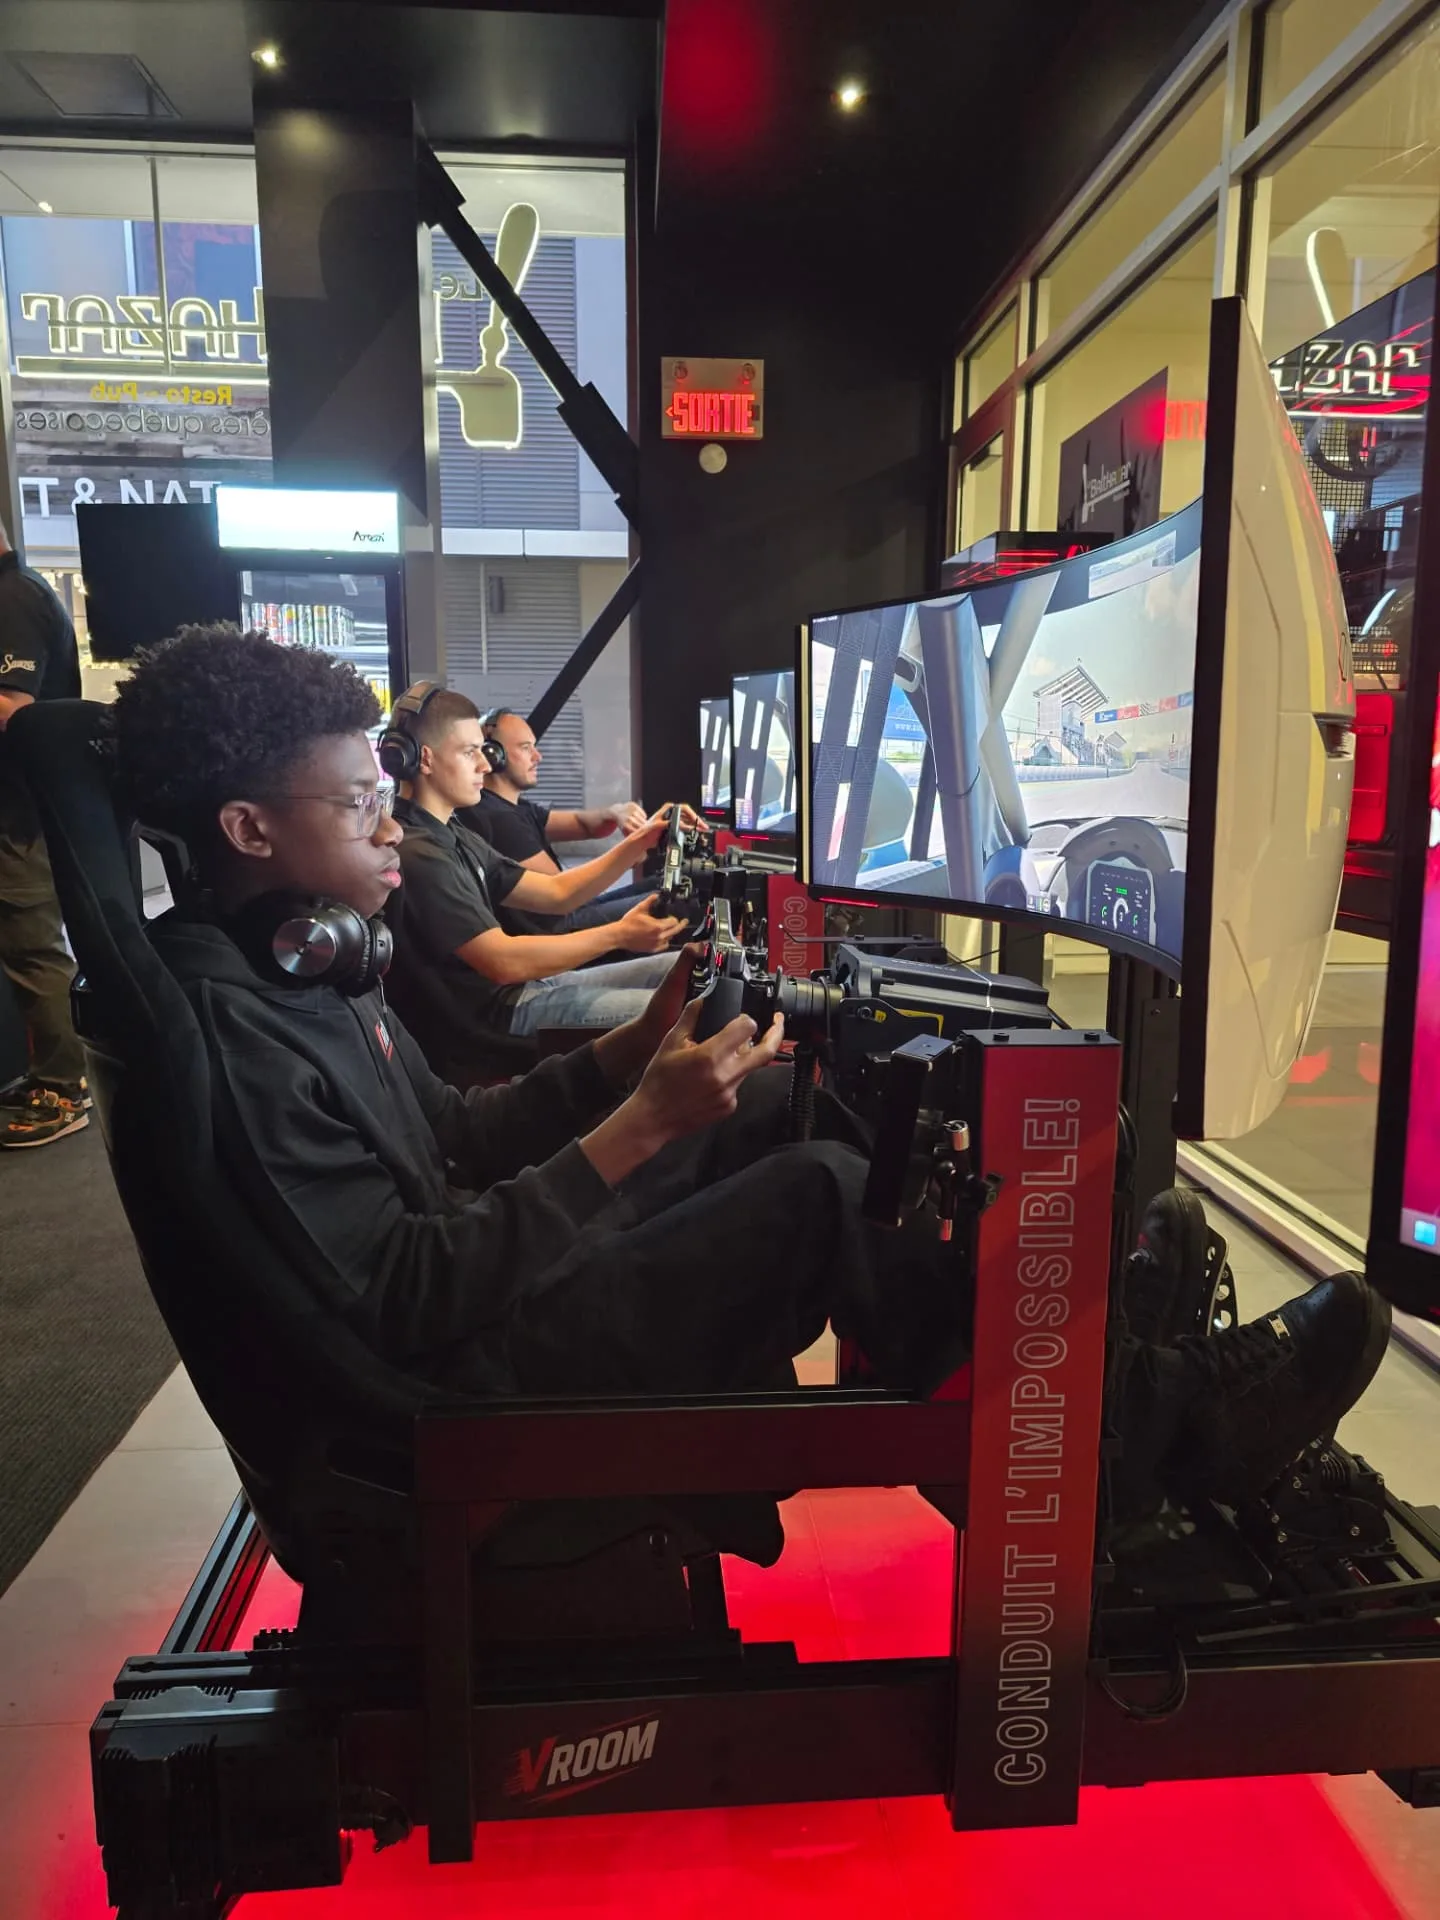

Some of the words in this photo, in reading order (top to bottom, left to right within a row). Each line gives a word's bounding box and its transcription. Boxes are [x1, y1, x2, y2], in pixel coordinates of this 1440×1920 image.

[673, 391, 756, 434] SORTIE
[71, 477, 104, 513] &
[1004, 1098, 1081, 1523] L'IMPOSSIBLE!
[994, 1544, 1057, 1786] CONDUIT
[516, 1719, 660, 1794] VROOM
